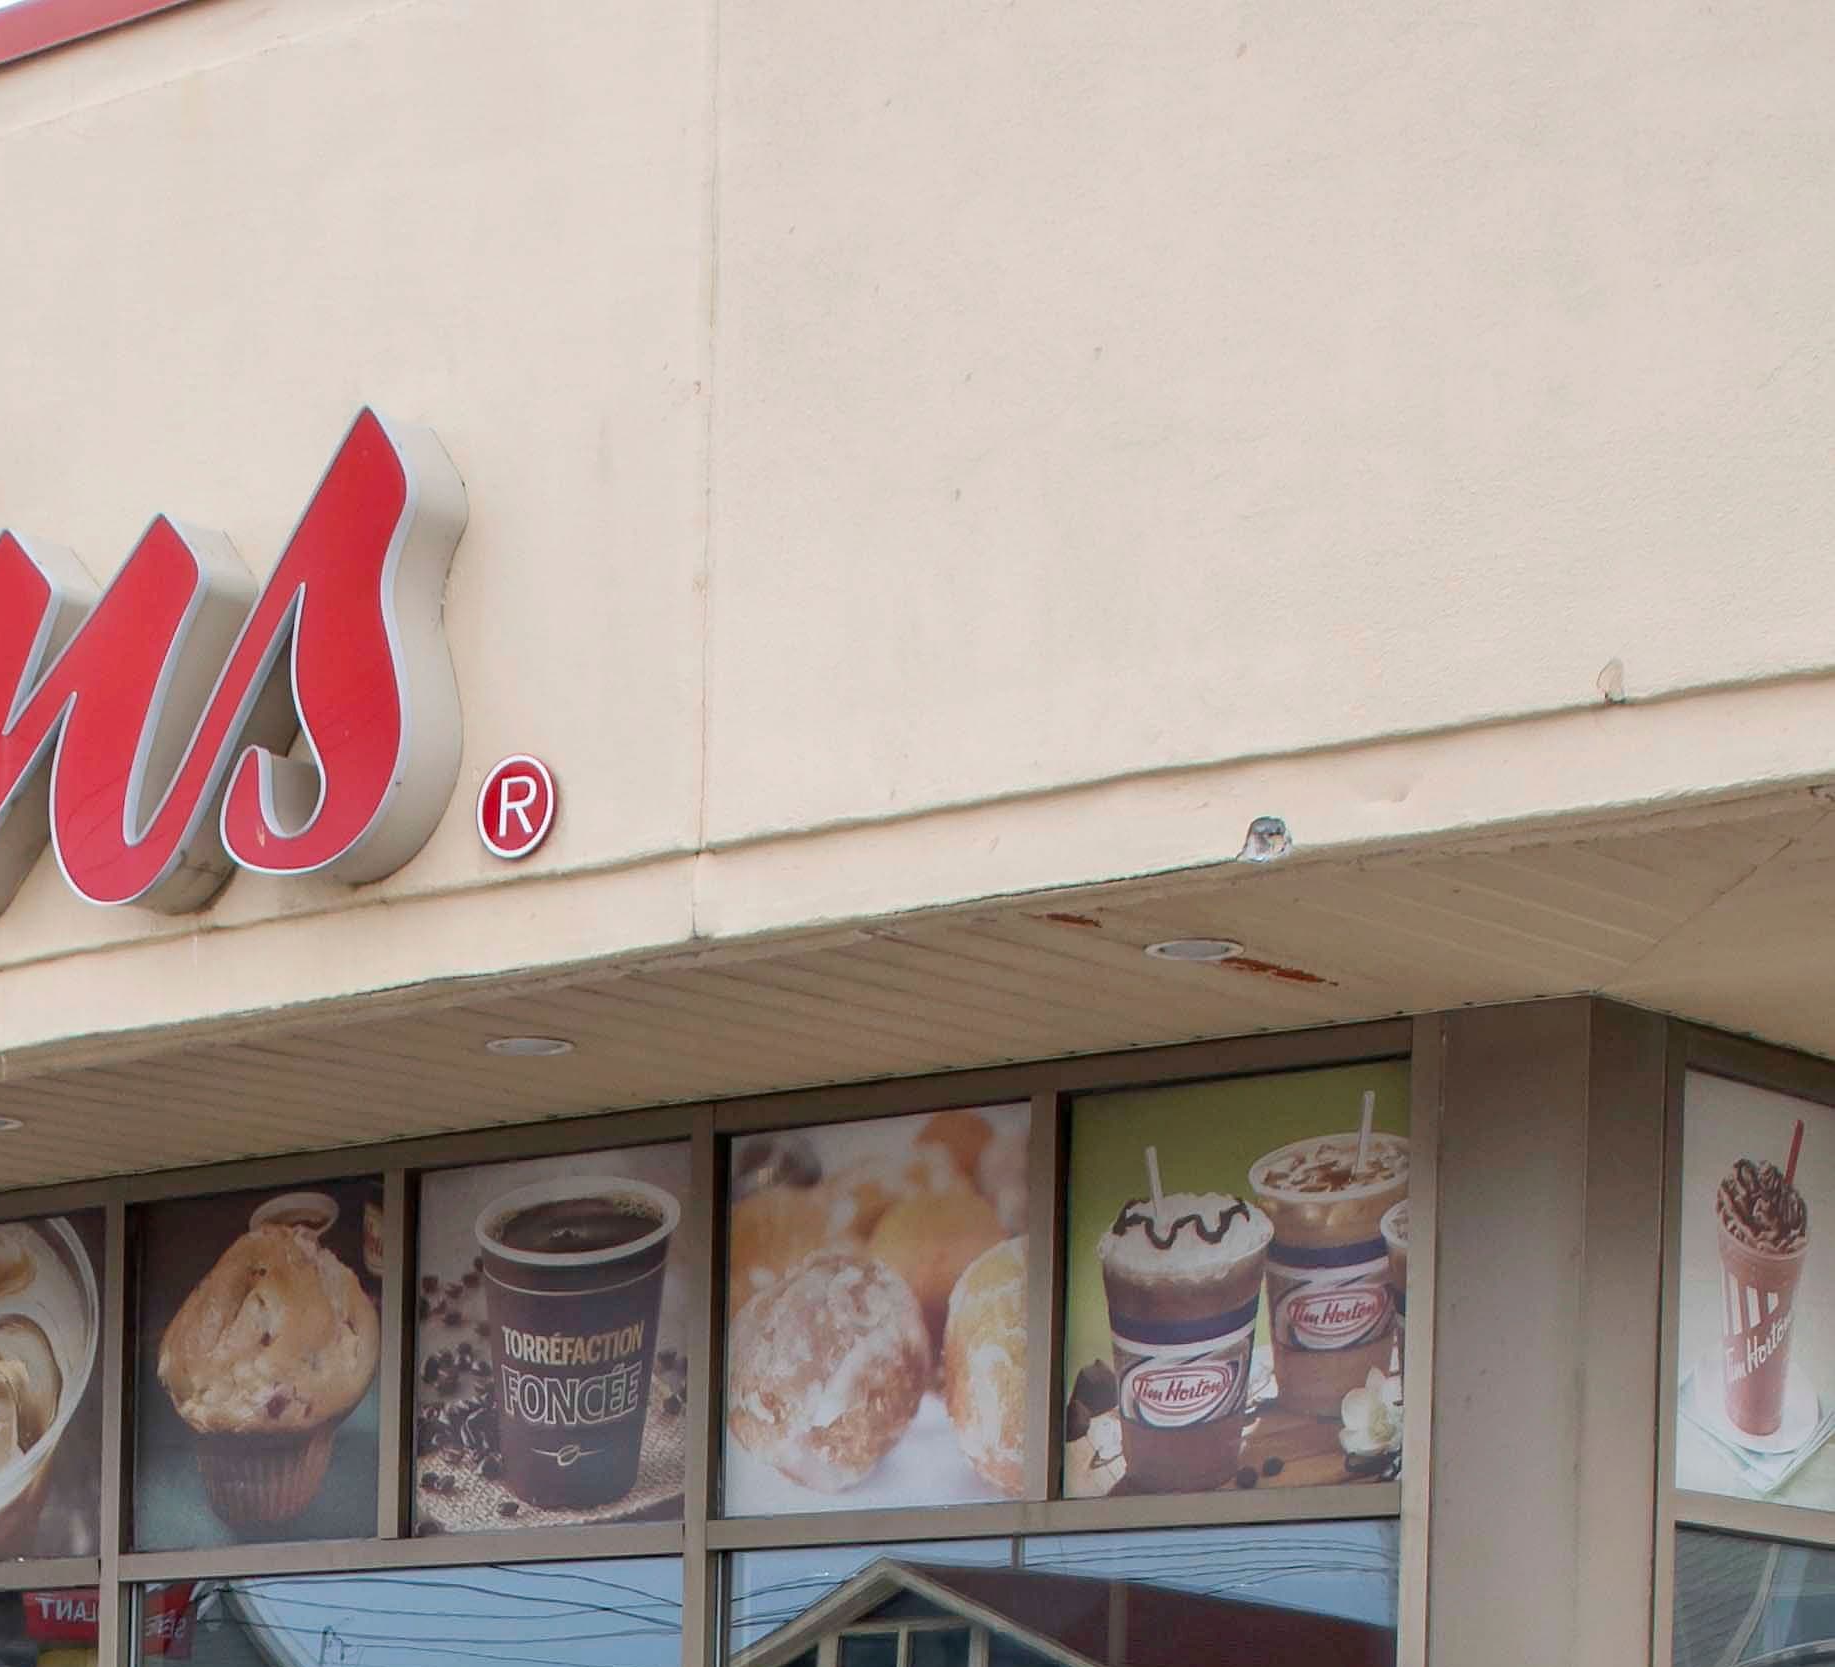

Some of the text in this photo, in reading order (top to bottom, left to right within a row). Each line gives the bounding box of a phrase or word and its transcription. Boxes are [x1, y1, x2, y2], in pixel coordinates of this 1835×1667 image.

[501, 1320, 645, 1365] TORRÉFACTION
[501, 1361, 643, 1424] FONCÉE
[1134, 1377, 1163, 1402] Tim
